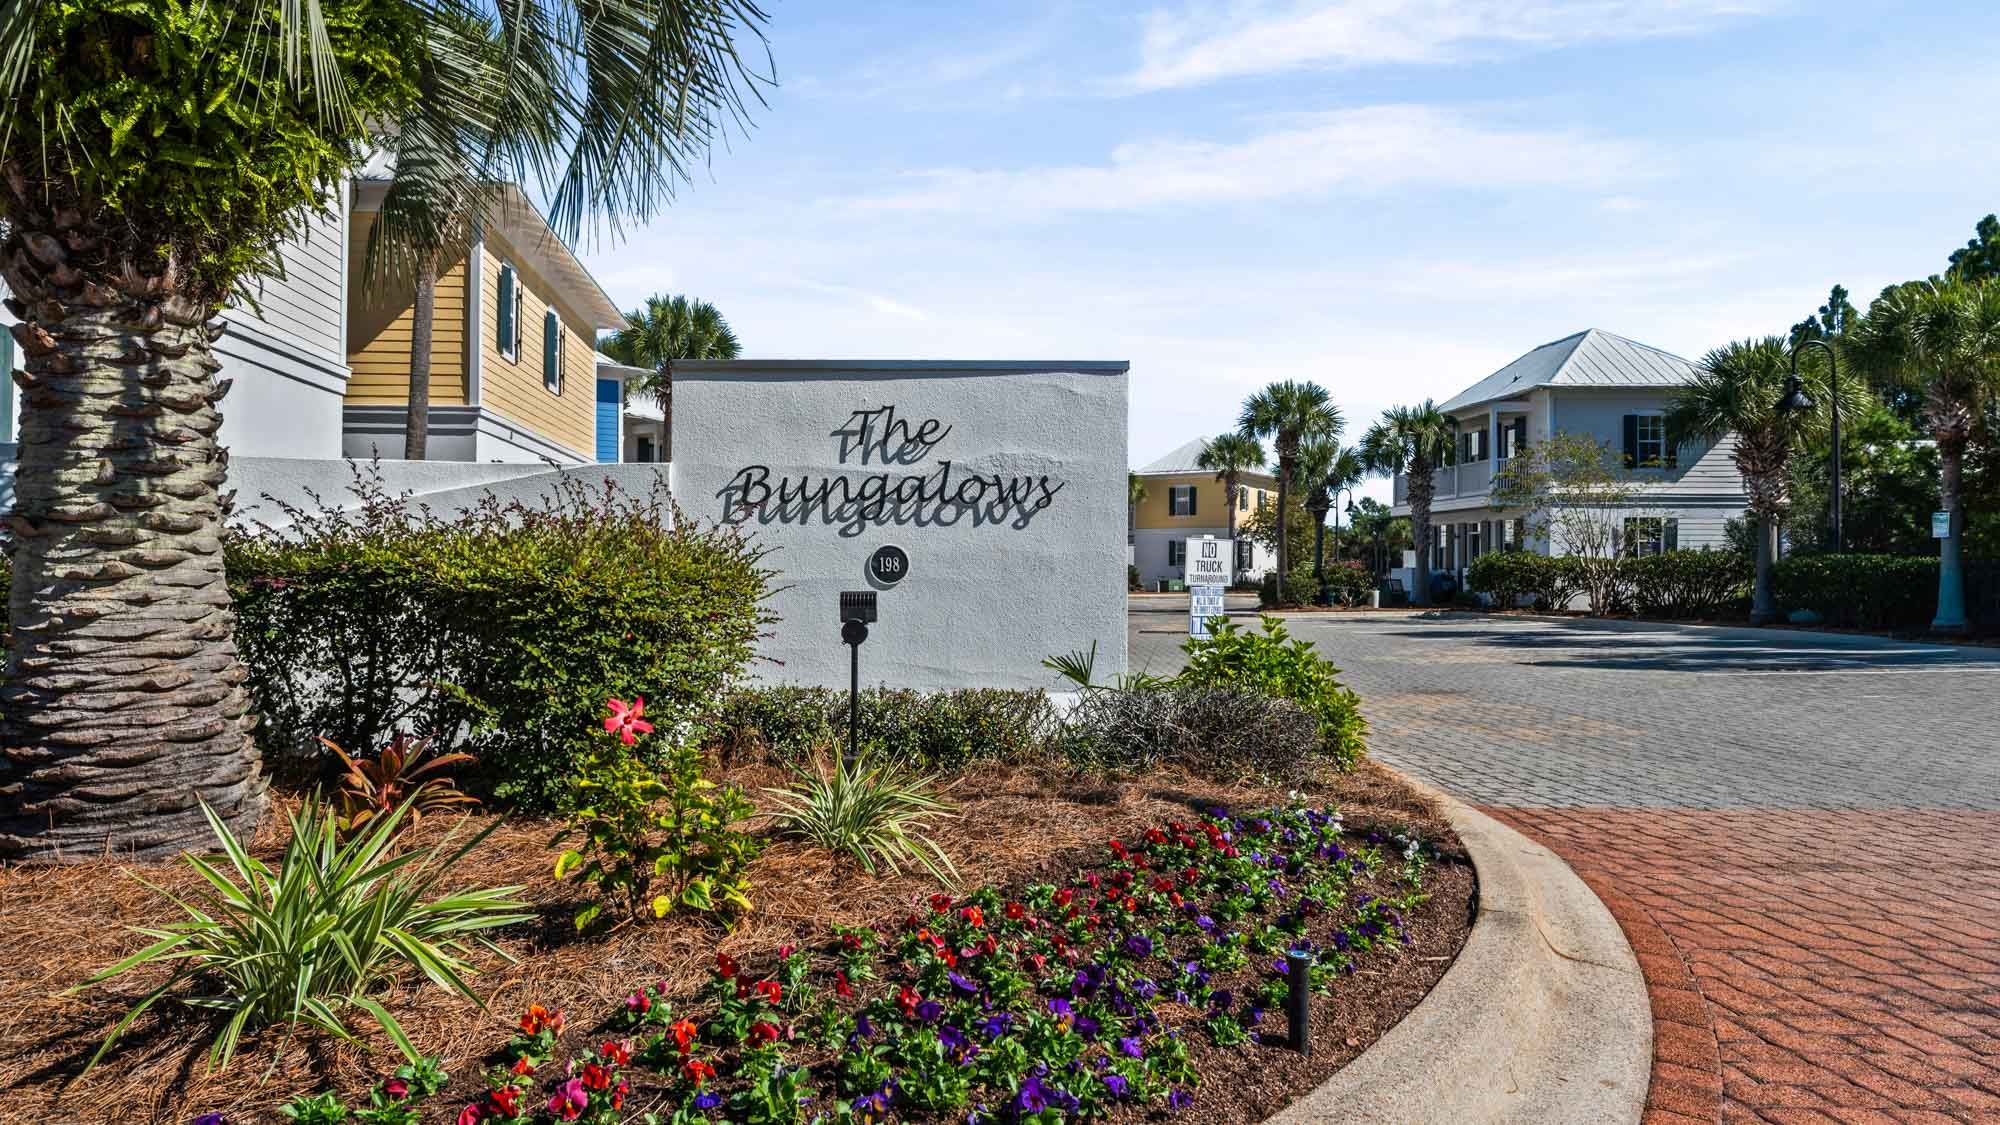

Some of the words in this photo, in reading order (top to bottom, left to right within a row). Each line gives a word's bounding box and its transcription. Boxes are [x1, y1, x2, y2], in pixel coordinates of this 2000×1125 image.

[851, 404, 953, 447] The
[734, 460, 1064, 521] Bungalows
[1202, 542, 1217, 558] NO
[880, 556, 900, 572] 198
[1195, 560, 1223, 573] TRUCK
